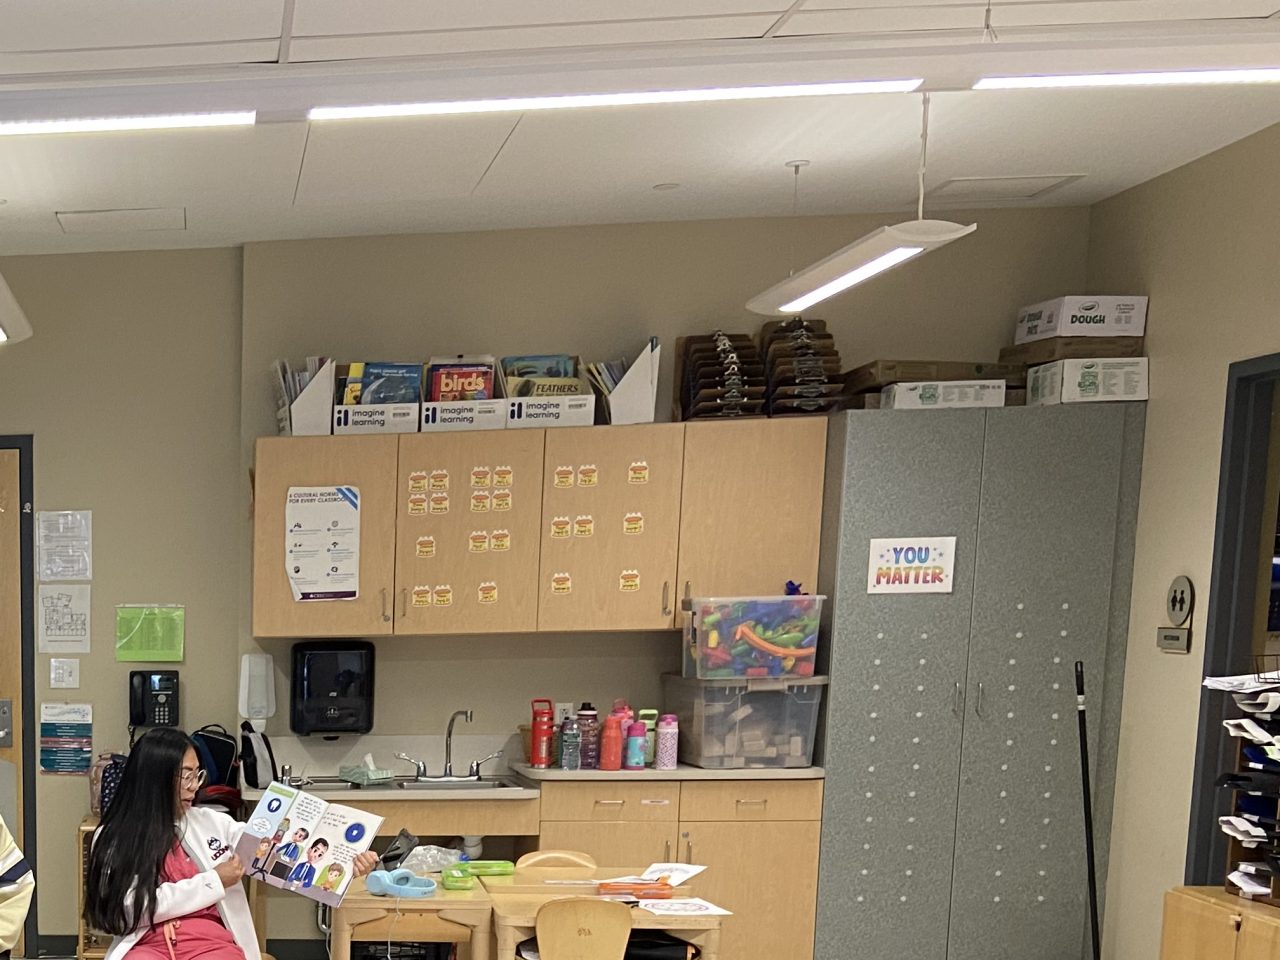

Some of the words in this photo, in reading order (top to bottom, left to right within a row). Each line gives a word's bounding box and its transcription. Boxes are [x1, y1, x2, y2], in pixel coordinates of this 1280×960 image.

[1071, 315, 1105, 324] DOUGH
[441, 372, 485, 392] birds
[536, 384, 578, 393] FEATHERS
[440, 406, 474, 415] imagine
[526, 402, 560, 411] imagine
[352, 409, 385, 418] imagine
[526, 412, 560, 420] learning
[352, 419, 385, 427] learning
[440, 415, 474, 424] learning
[892, 546, 930, 564] YOU
[876, 566, 944, 585] MATTER
